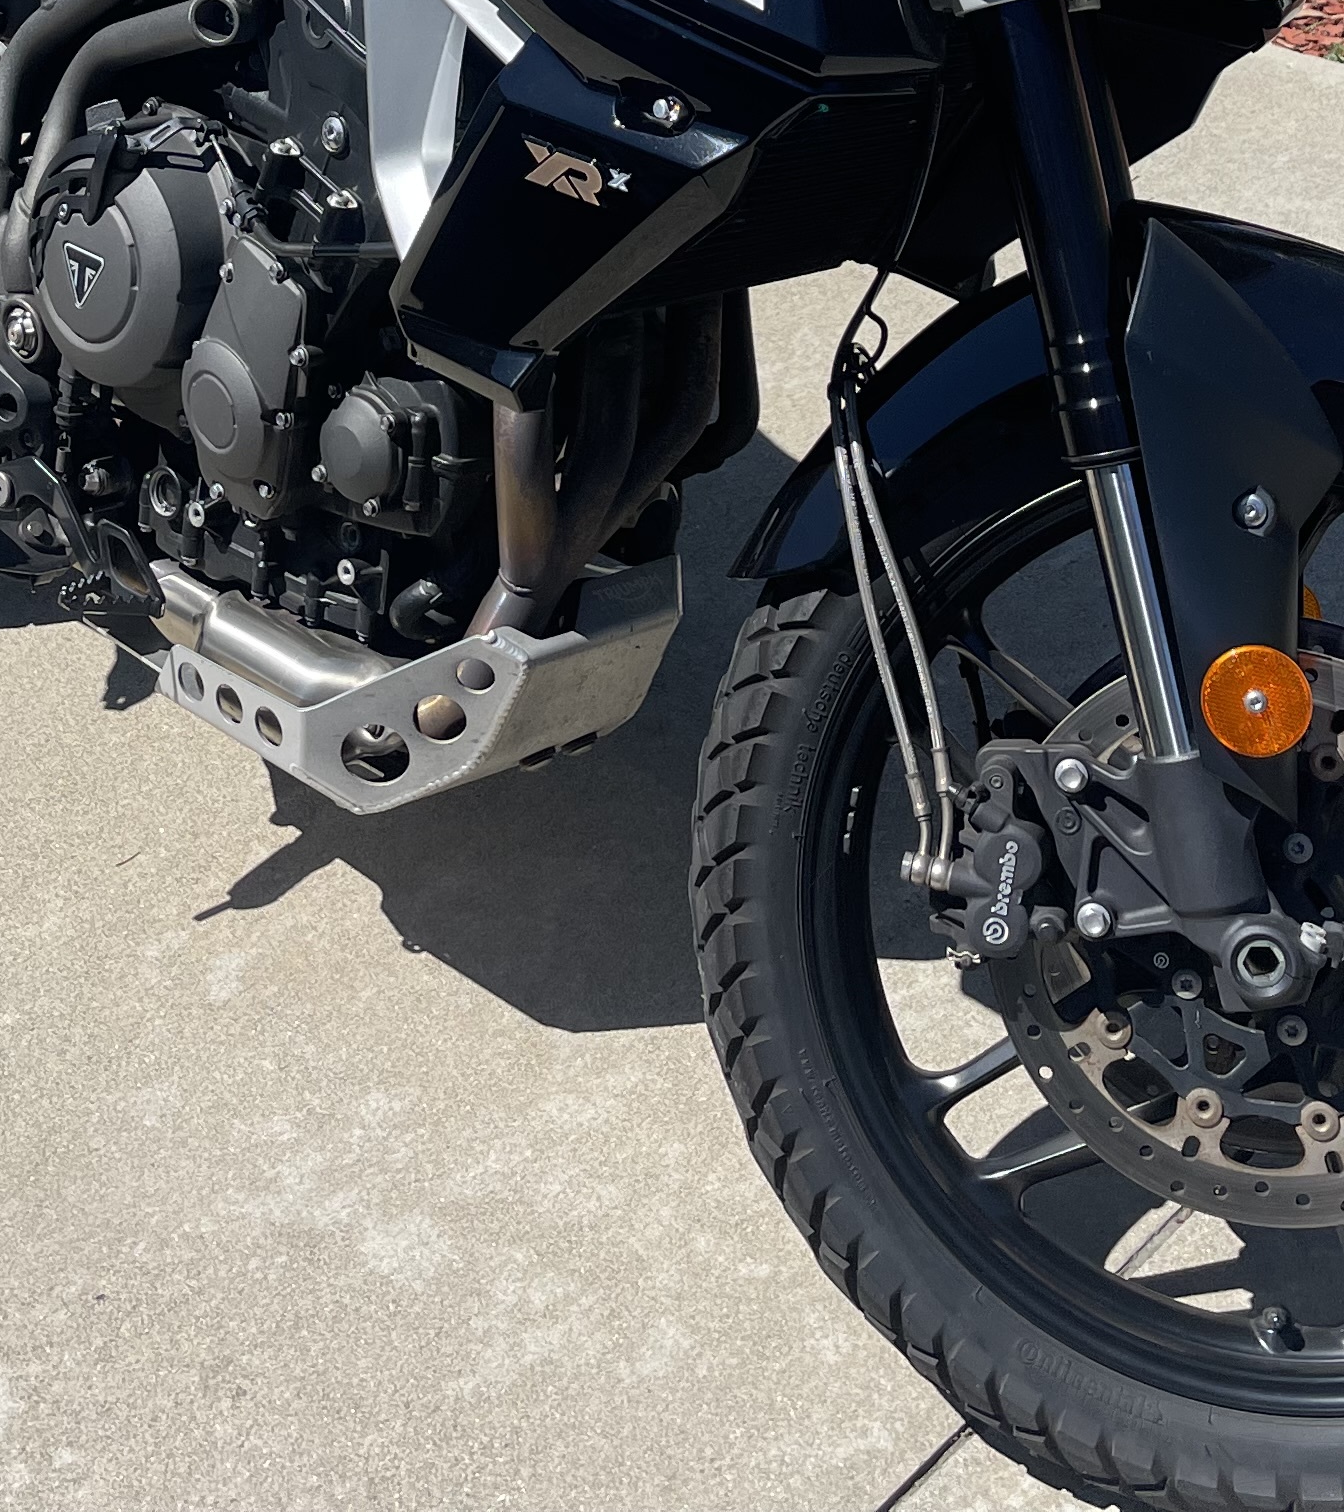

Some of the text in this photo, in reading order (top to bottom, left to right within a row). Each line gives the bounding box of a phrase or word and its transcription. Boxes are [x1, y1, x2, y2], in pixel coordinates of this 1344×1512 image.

[782, 652, 852, 815] deutsche technik
[990, 840, 1019, 917] brembo
